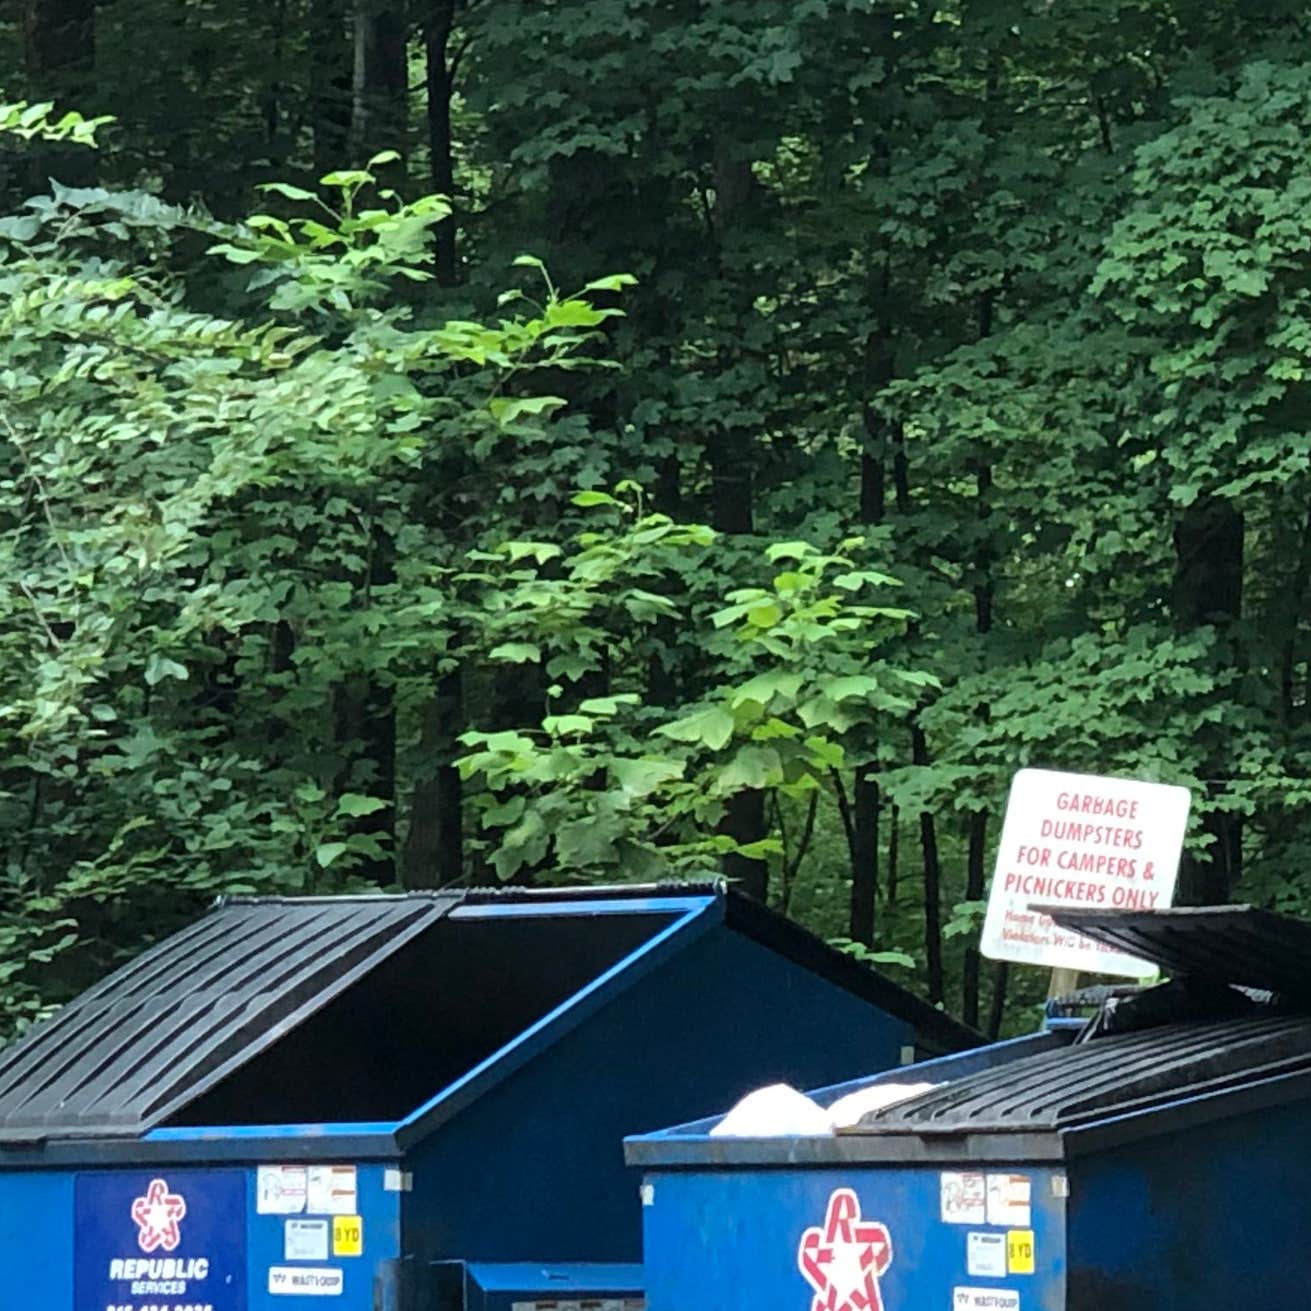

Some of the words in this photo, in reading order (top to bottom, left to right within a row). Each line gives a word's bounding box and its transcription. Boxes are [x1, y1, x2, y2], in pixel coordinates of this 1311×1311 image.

[1056, 792, 1139, 819] GARBAGE
[1040, 819, 1144, 850] DUMPSTERS
[1016, 845, 1051, 867] FOR
[1057, 850, 1136, 880] CAMPERS
[1143, 861, 1155, 880] &
[1004, 873, 1107, 904] PICNICKERS
[1112, 886, 1159, 909] ONLY
[109, 1258, 209, 1280] REPUBLIC
[131, 1281, 186, 1295] SERVICES
